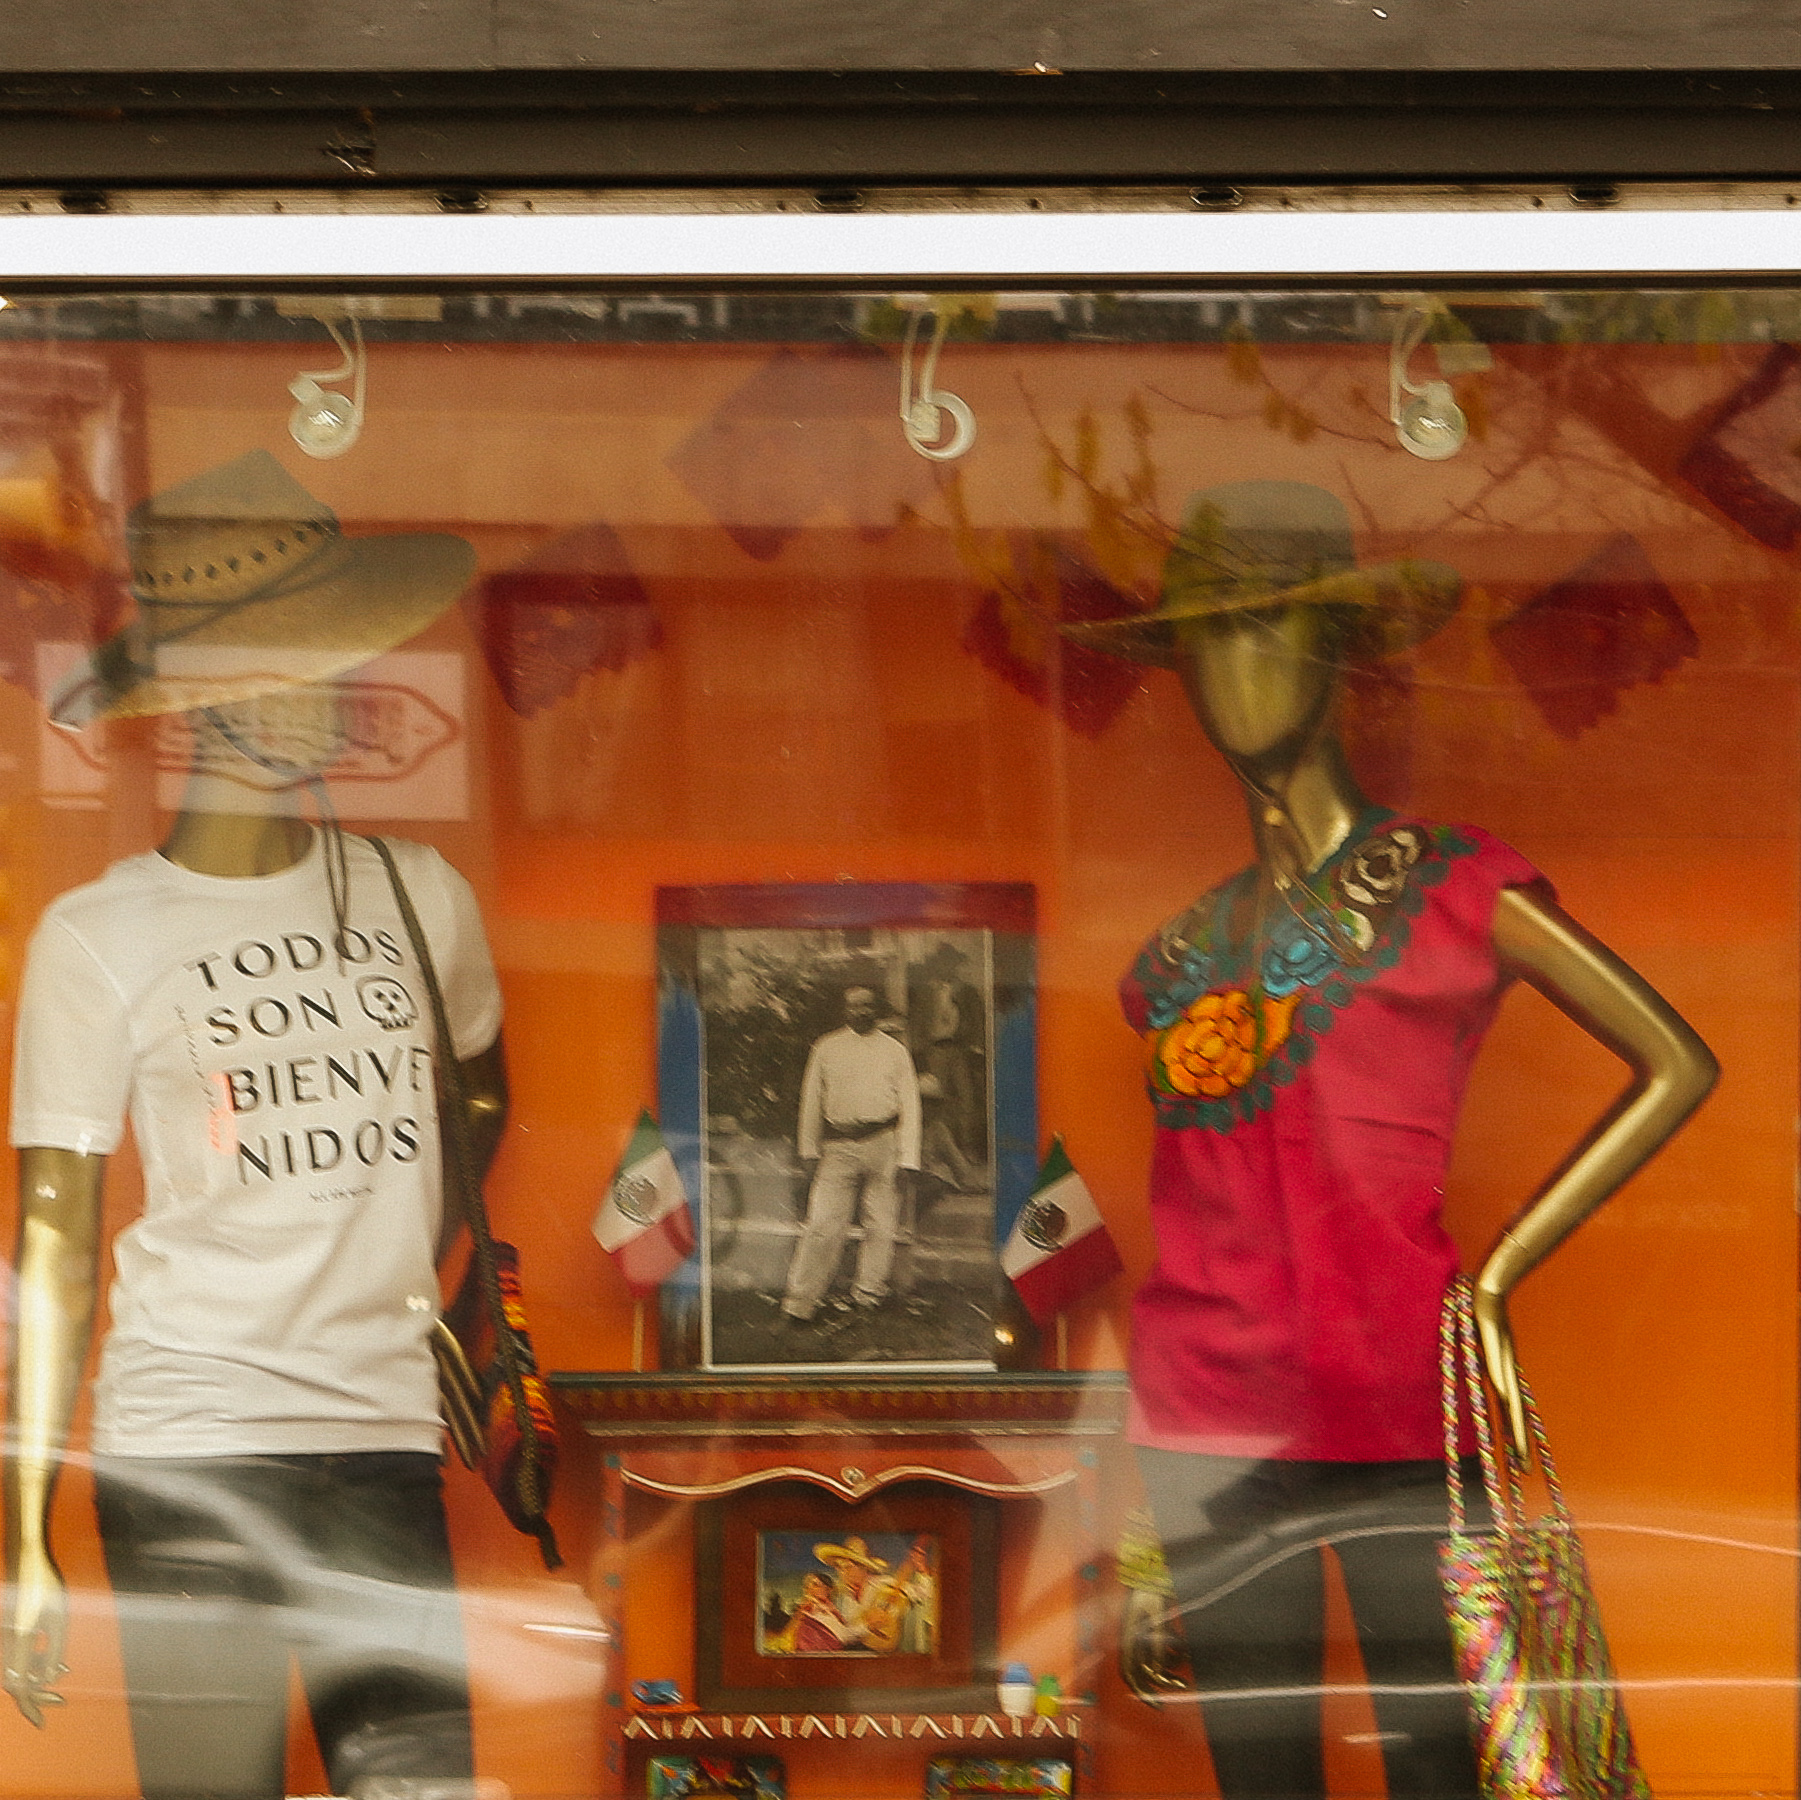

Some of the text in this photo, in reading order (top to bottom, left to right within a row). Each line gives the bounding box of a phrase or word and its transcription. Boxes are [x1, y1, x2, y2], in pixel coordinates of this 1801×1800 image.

[184, 927, 404, 990] TODOS
[205, 988, 342, 1047] SON
[224, 1045, 432, 1115] BIENVE
[236, 1116, 422, 1185] NIDOS
